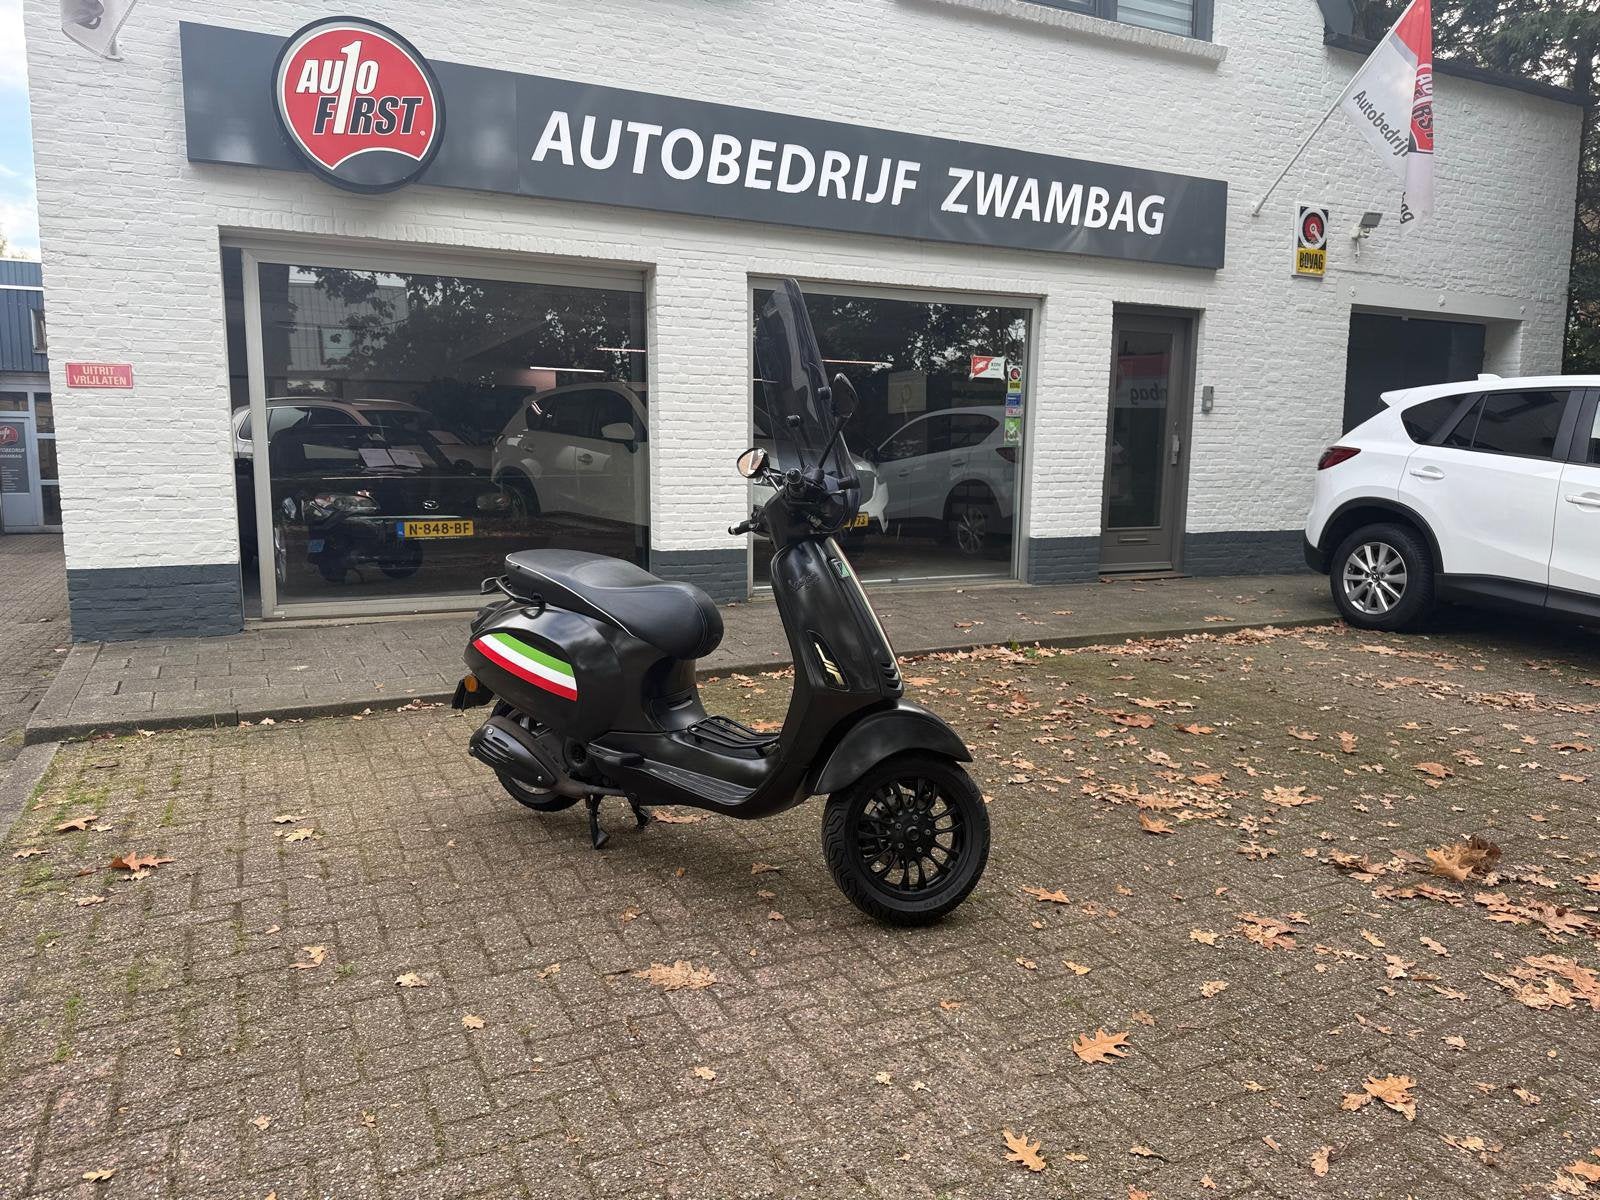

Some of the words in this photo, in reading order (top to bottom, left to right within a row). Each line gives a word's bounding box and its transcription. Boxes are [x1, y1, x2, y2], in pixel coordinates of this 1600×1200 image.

[312, 95, 424, 135] FIRST
[531, 110, 921, 206] AUTOBEDRIJF
[940, 167, 1166, 236] ZWAMBAG
[1299, 252, 1324, 270] BOVAG
[82, 365, 115, 375] UITRIT
[73, 375, 127, 385] VRIJLATEN
[408, 522, 470, 536] N-848-BF
